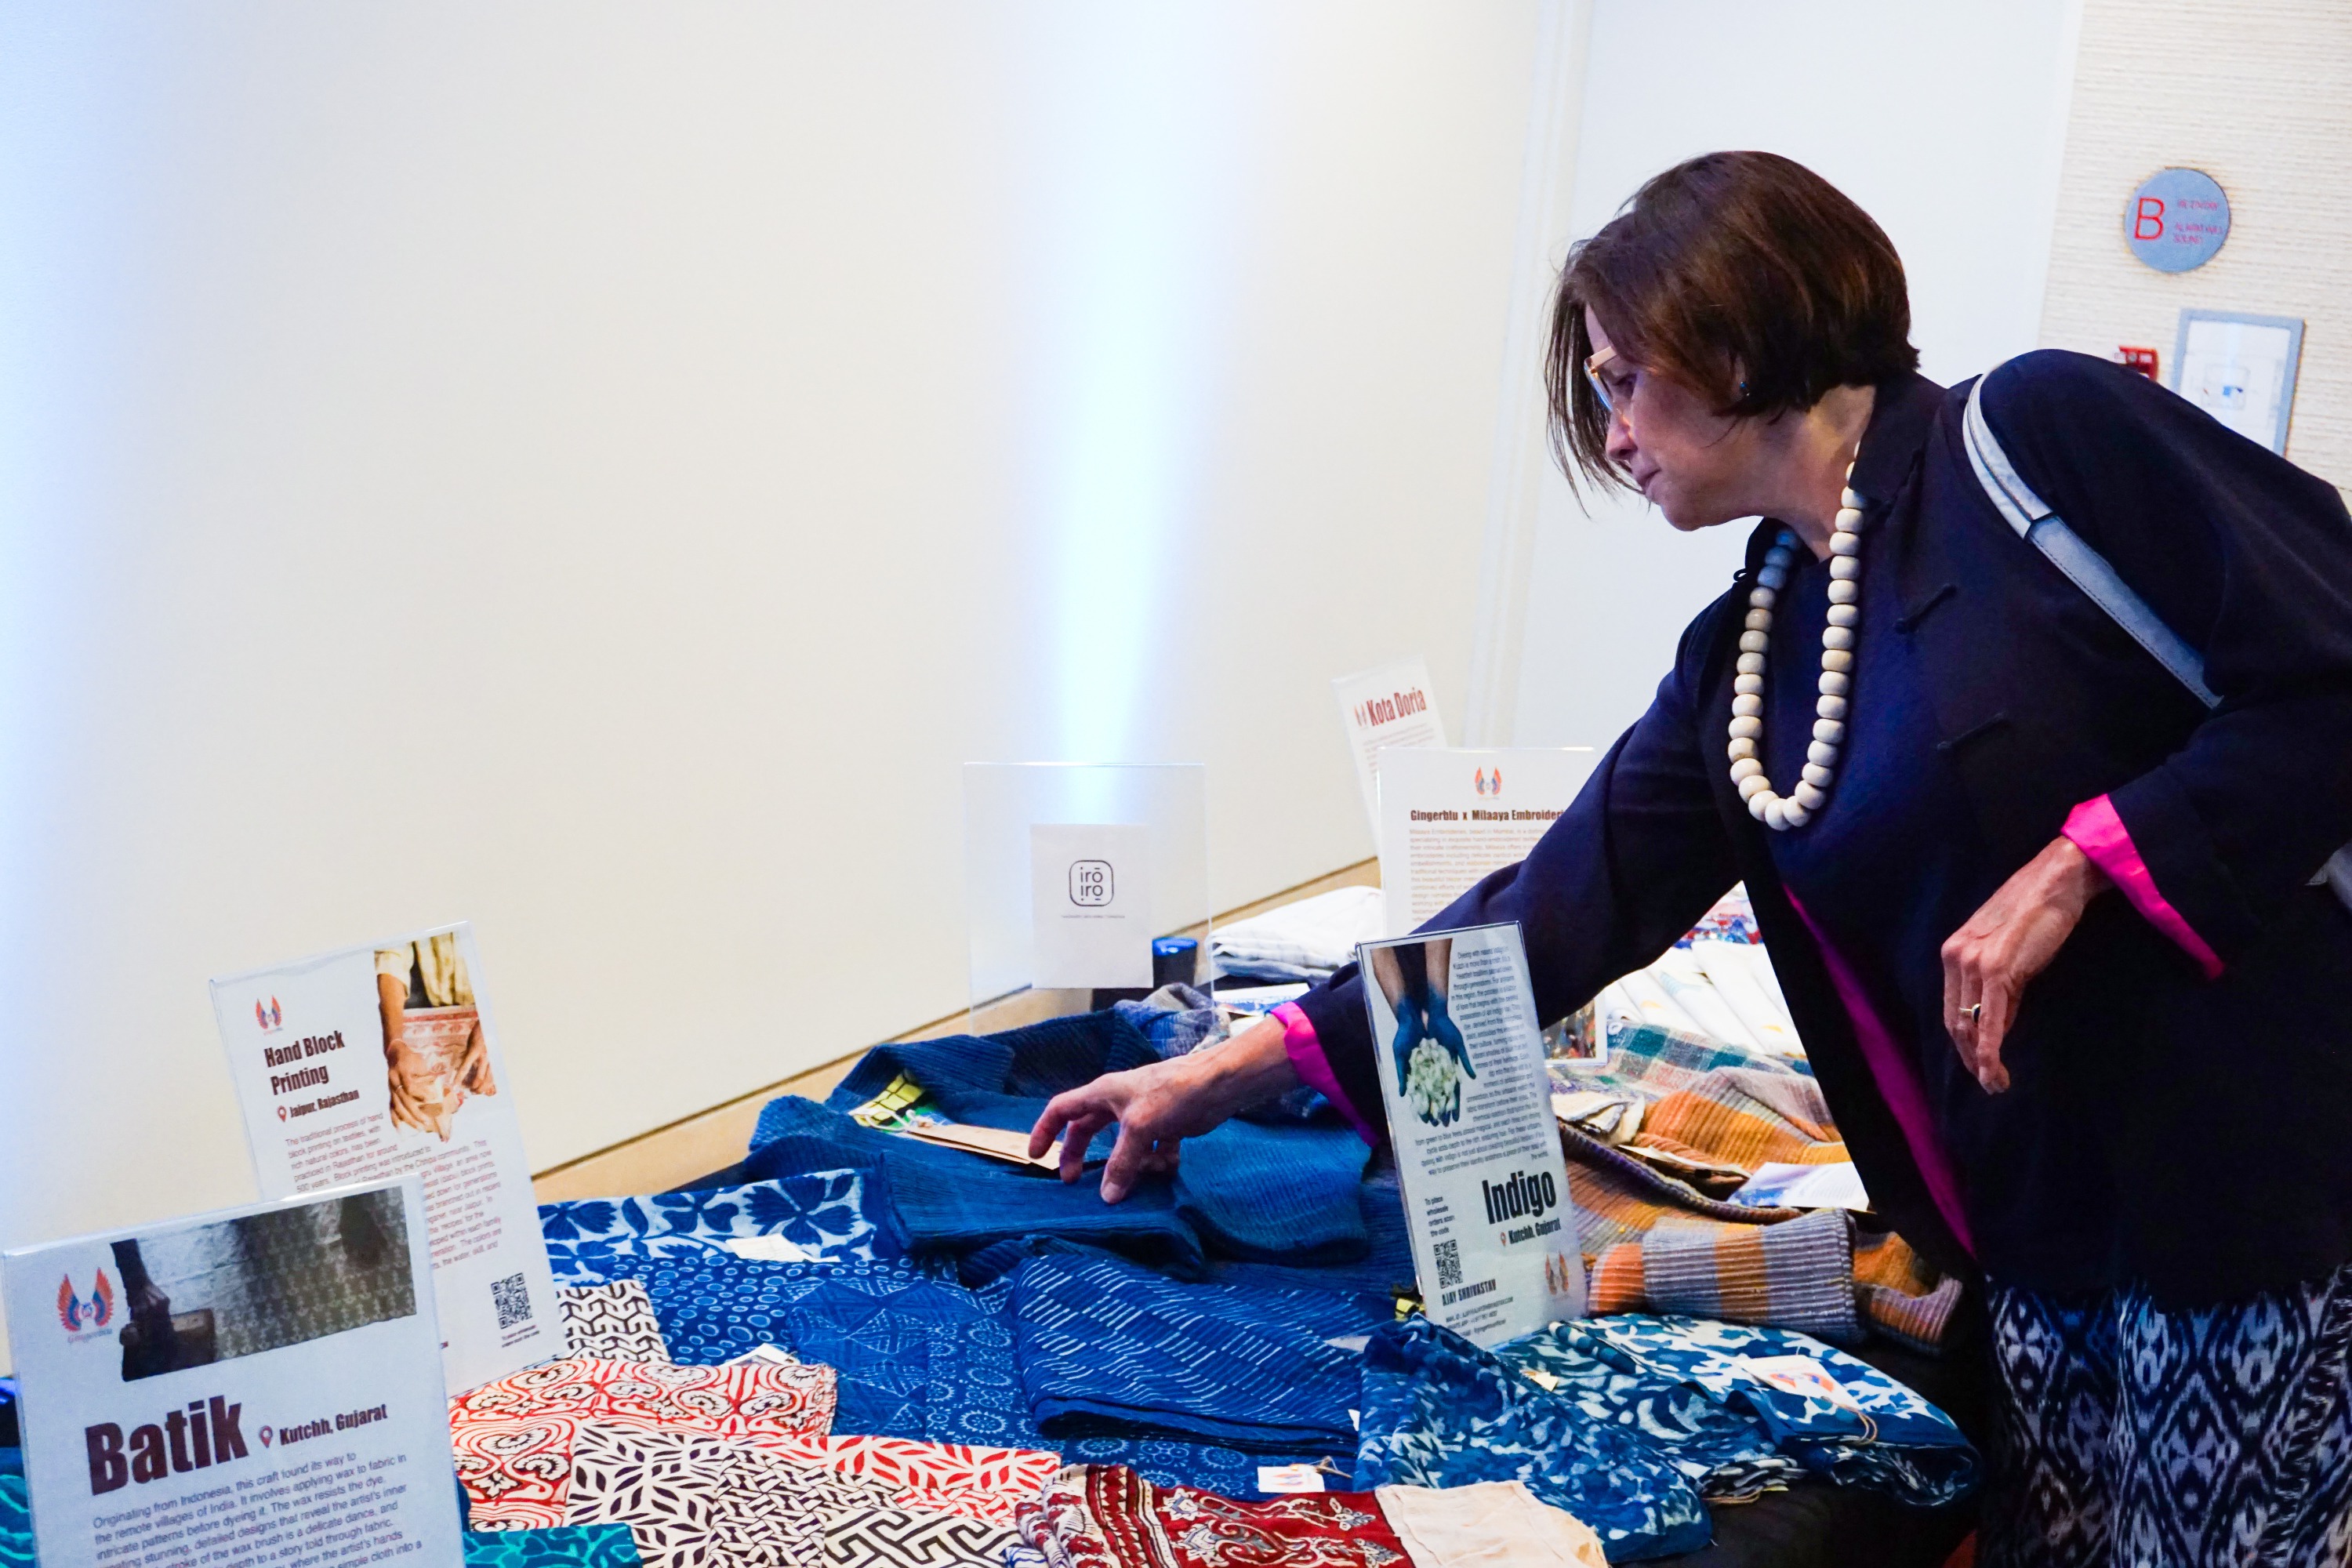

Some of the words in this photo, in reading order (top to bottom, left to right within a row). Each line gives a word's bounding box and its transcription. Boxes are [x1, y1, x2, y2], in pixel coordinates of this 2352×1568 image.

[2134, 197, 2165, 241] B
[1367, 699, 1396, 726] Kota
[1394, 687, 1427, 719] Doria
[1410, 810, 1458, 822] Gingerblu
[1462, 811, 1468, 821] x
[1472, 810, 1509, 822] Milaaya
[264, 1040, 303, 1068] Hand
[304, 1030, 345, 1057] Block
[270, 1065, 329, 1095] Printing
[1482, 1171, 1557, 1225] Indigo
[1508, 1225, 1535, 1244] Kutchh,
[1535, 1218, 1561, 1237] Gujarat
[1442, 1292, 1457, 1306] AJAY
[1458, 1279, 1497, 1301] SHRIVASTAV
[85, 1395, 249, 1496] Batik
[279, 1419, 333, 1446] Kutchh,
[336, 1404, 387, 1431] Gujarat
[93, 1507, 151, 1529] Originating
[153, 1499, 178, 1512] from
[180, 1486, 233, 1506] Indonesia,
[236, 1480, 254, 1491] this
[256, 1471, 279, 1486] craft
[281, 1463, 309, 1479] found
[311, 1461, 322, 1471] its
[325, 1456, 344, 1467] way
[347, 1453, 356, 1461] to
[95, 1534, 112, 1544] the
[115, 1523, 152, 1539] remote
[154, 1512, 194, 1528] villages
[197, 1505, 207, 1517] of
[210, 1501, 237, 1514] India.
[249, 1486, 290, 1503] involves
[293, 1475, 333, 1492] applying
[336, 1469, 354, 1479] wax
[357, 1465, 366, 1474] to
[368, 1457, 395, 1470] fabric
[397, 1454, 406, 1463] in
[96, 1542, 139, 1560] intricate
[142, 1530, 184, 1551] patterns
[187, 1521, 220, 1536] before
[223, 1511, 256, 1527] dyeing
[270, 1501, 290, 1512] The
[292, 1496, 312, 1507] wax
[314, 1486, 347, 1501] resists
[348, 1482, 363, 1492] the
[366, 1476, 386, 1488] dye.
[144, 1544, 191, 1564] stunning,
[194, 1530, 235, 1549] detailed
[238, 1520, 277, 1537] designs
[278, 1514, 298, 1526] that
[301, 1504, 330, 1520] reveal
[332, 1501, 348, 1512] the
[350, 1491, 381, 1507] artist's
[383, 1485, 406, 1497] inner
[200, 1552, 210, 1564] of
[212, 1550, 228, 1560] the
[231, 1544, 252, 1555] wax
[255, 1534, 283, 1549] brush
[285, 1531, 294, 1540] is
[297, 1529, 303, 1537] a
[305, 1518, 343, 1534] delicate
[345, 1509, 377, 1523] dance,
[380, 1501, 397, 1514] and
[256, 1555, 267, 1564] to
[270, 1552, 277, 1561] a
[279, 1545, 303, 1558] story
[305, 1537, 323, 1550] told
[325, 1527, 363, 1544] through
[365, 1519, 394, 1533] fabric.
[322, 1550, 338, 1561] the
[340, 1540, 372, 1555] artist's
[373, 1531, 403, 1545] hands
[371, 1548, 394, 1562] cloth
[396, 1543, 413, 1555] into
[416, 1541, 422, 1549] a
